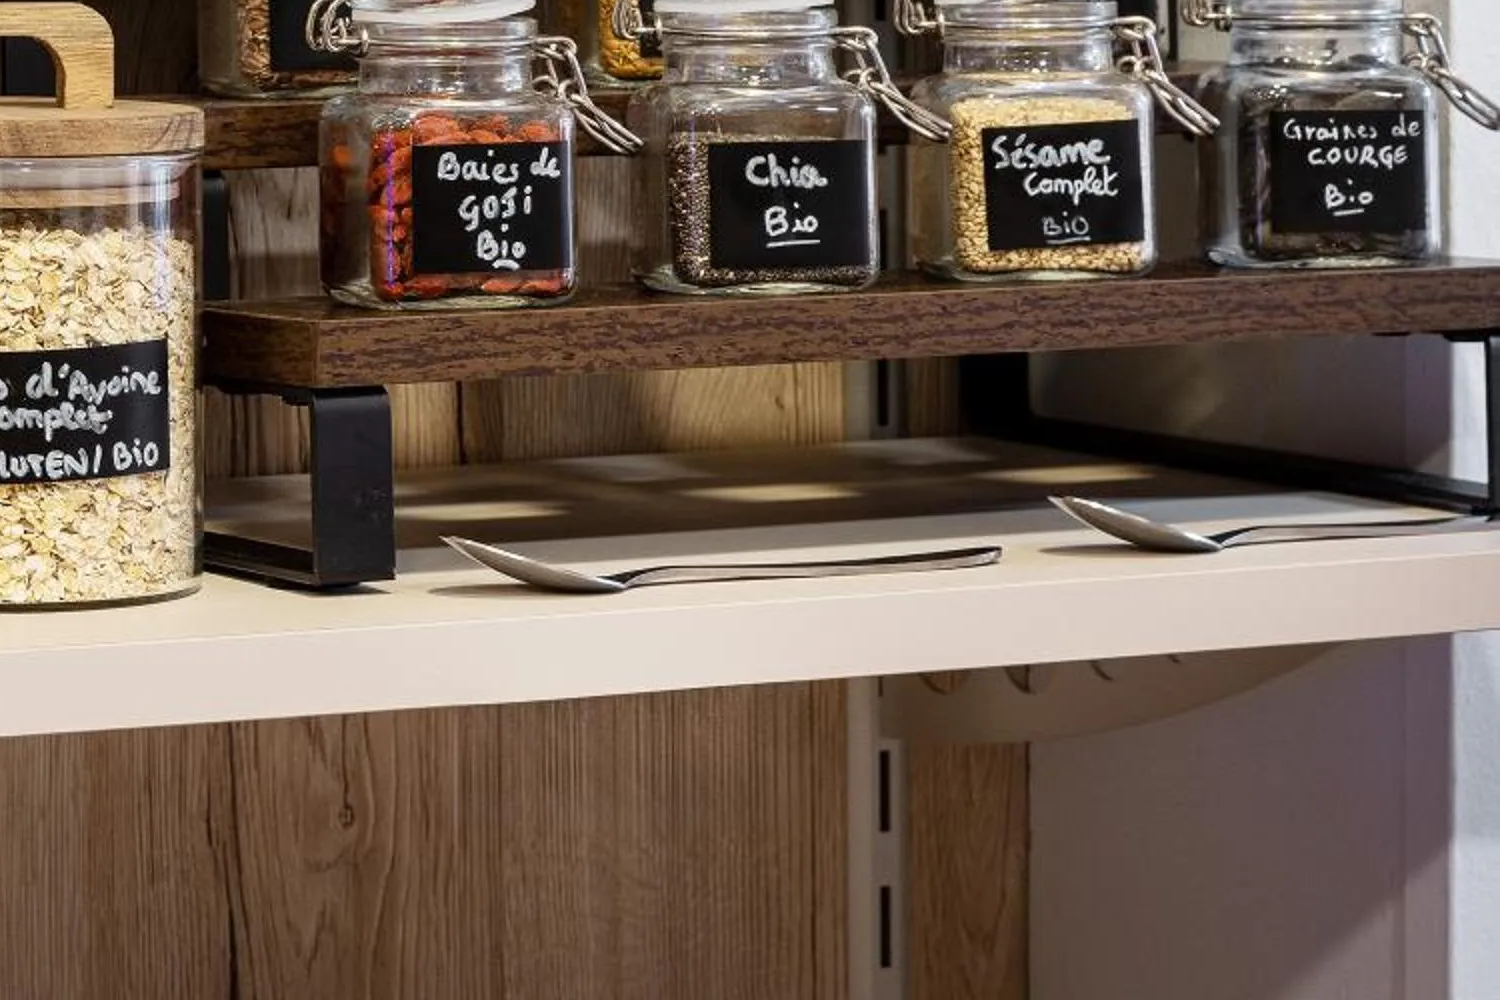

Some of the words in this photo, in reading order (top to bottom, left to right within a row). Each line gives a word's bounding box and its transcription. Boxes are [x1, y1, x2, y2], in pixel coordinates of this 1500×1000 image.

[1283, 117, 1378, 141] Graines
[1391, 113, 1421, 137] de
[437, 149, 520, 184] Baies
[530, 147, 561, 179] de
[991, 133, 1111, 169] Sésame
[1307, 144, 1409, 170] COURGE
[745, 152, 829, 189] Chia
[1324, 177, 1373, 209] Bio
[764, 202, 819, 237] Bio
[476, 223, 527, 261] Bio
